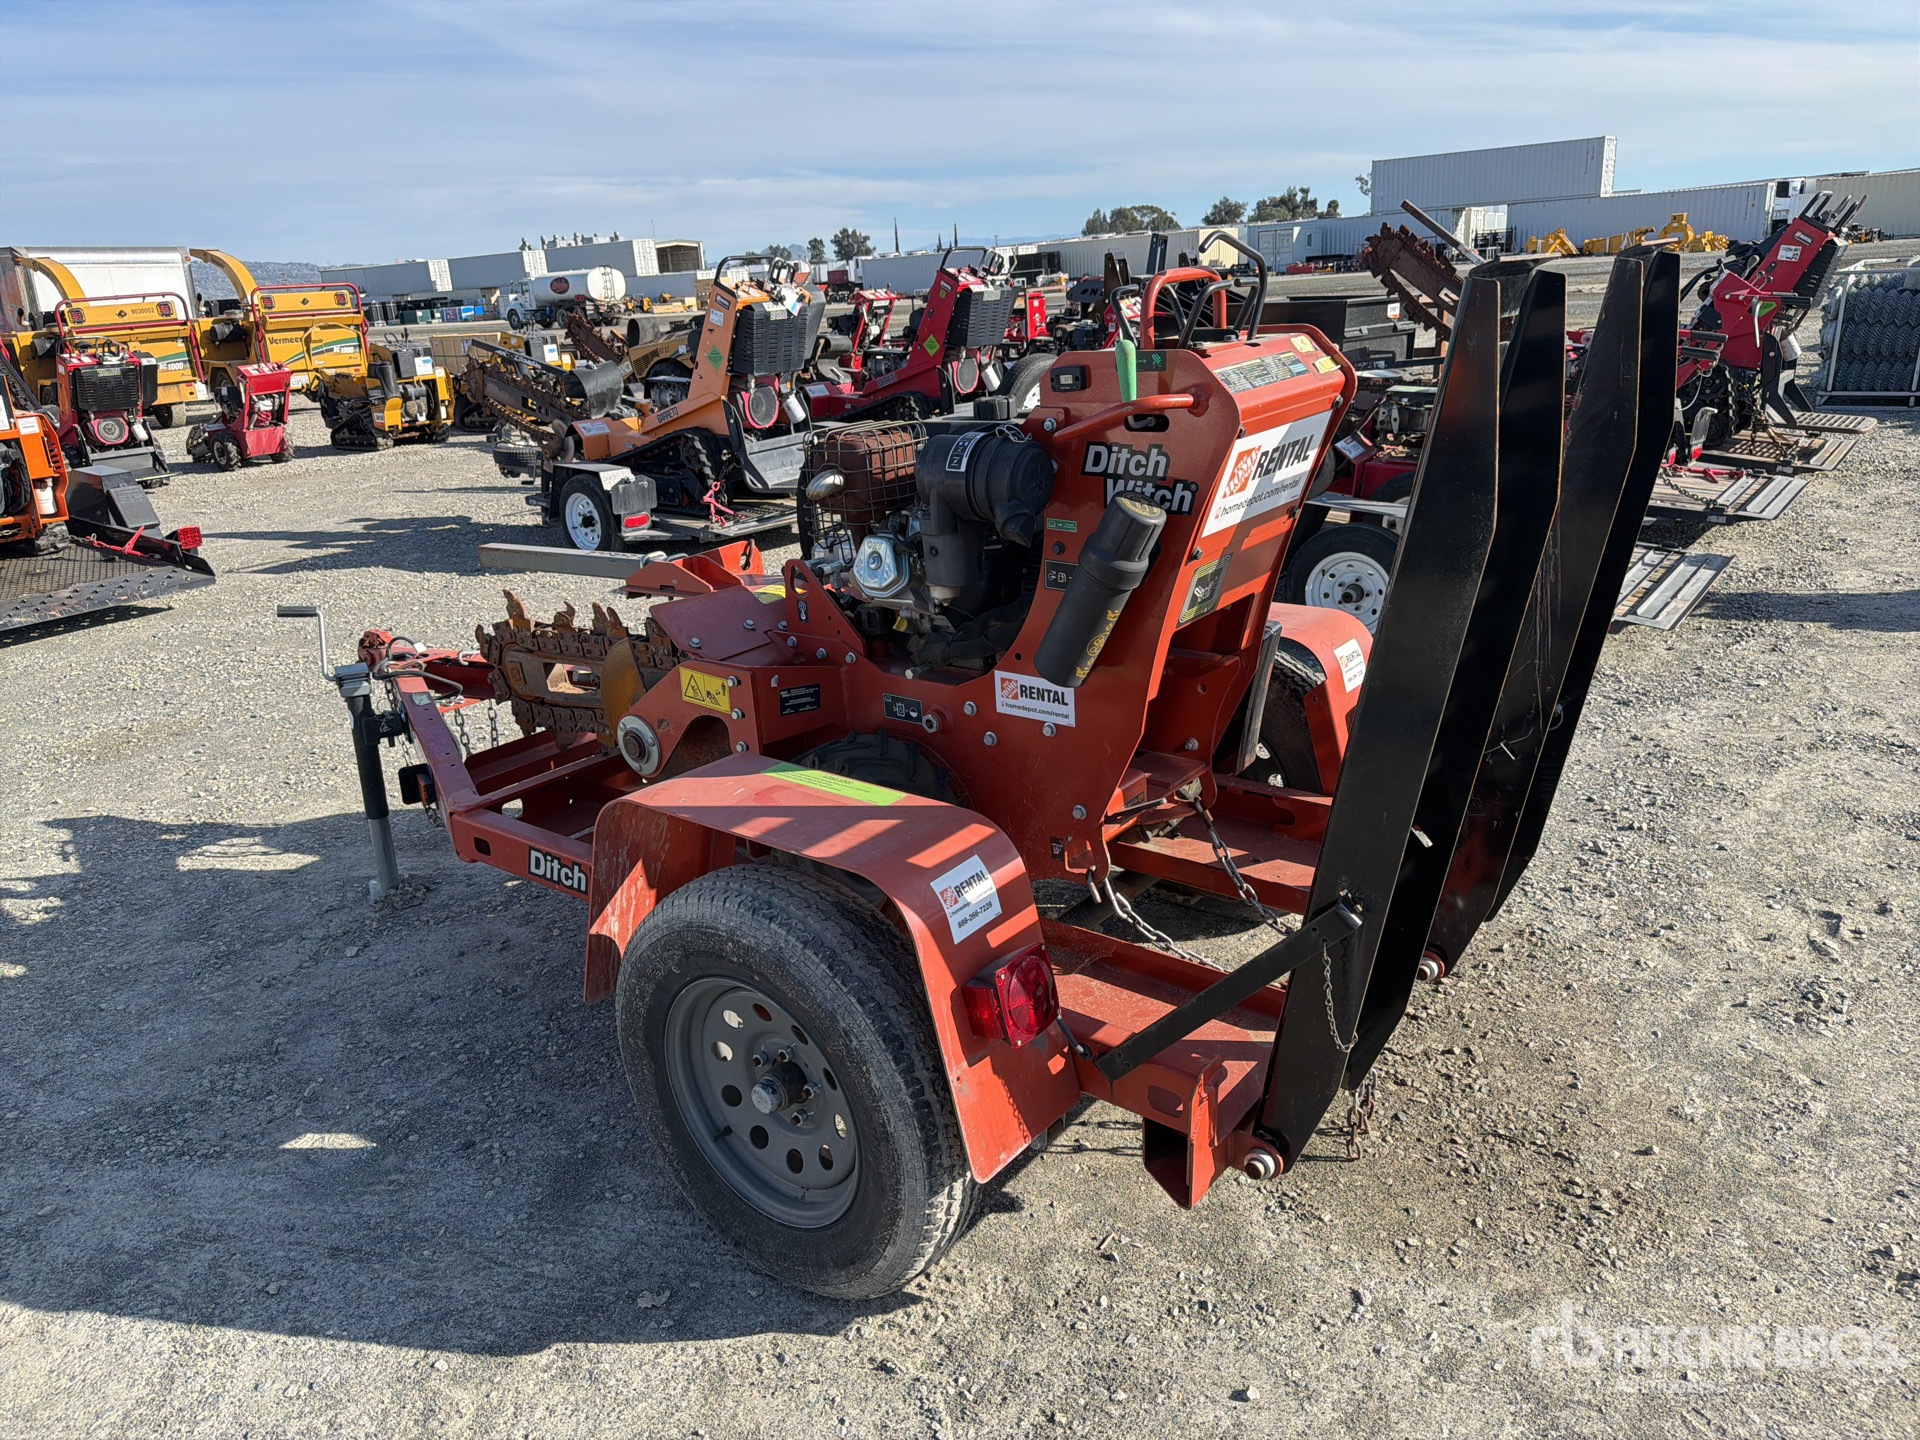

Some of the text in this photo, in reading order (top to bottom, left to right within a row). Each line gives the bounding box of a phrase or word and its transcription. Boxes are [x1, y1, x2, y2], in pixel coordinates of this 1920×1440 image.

[267, 336, 304, 345] Vermeer
[340, 346, 354, 354] 1000
[168, 362, 184, 371] 1000
[1084, 444, 1168, 478] Ditch
[1251, 433, 1315, 482] RENTAL
[1220, 476, 1302, 517] homedepot.com/rental
[1019, 683, 1069, 707] RENTAL
[1005, 701, 1070, 720] homedepot.com/rental
[530, 849, 587, 892] Ditch
[953, 869, 989, 899] RENTAL
